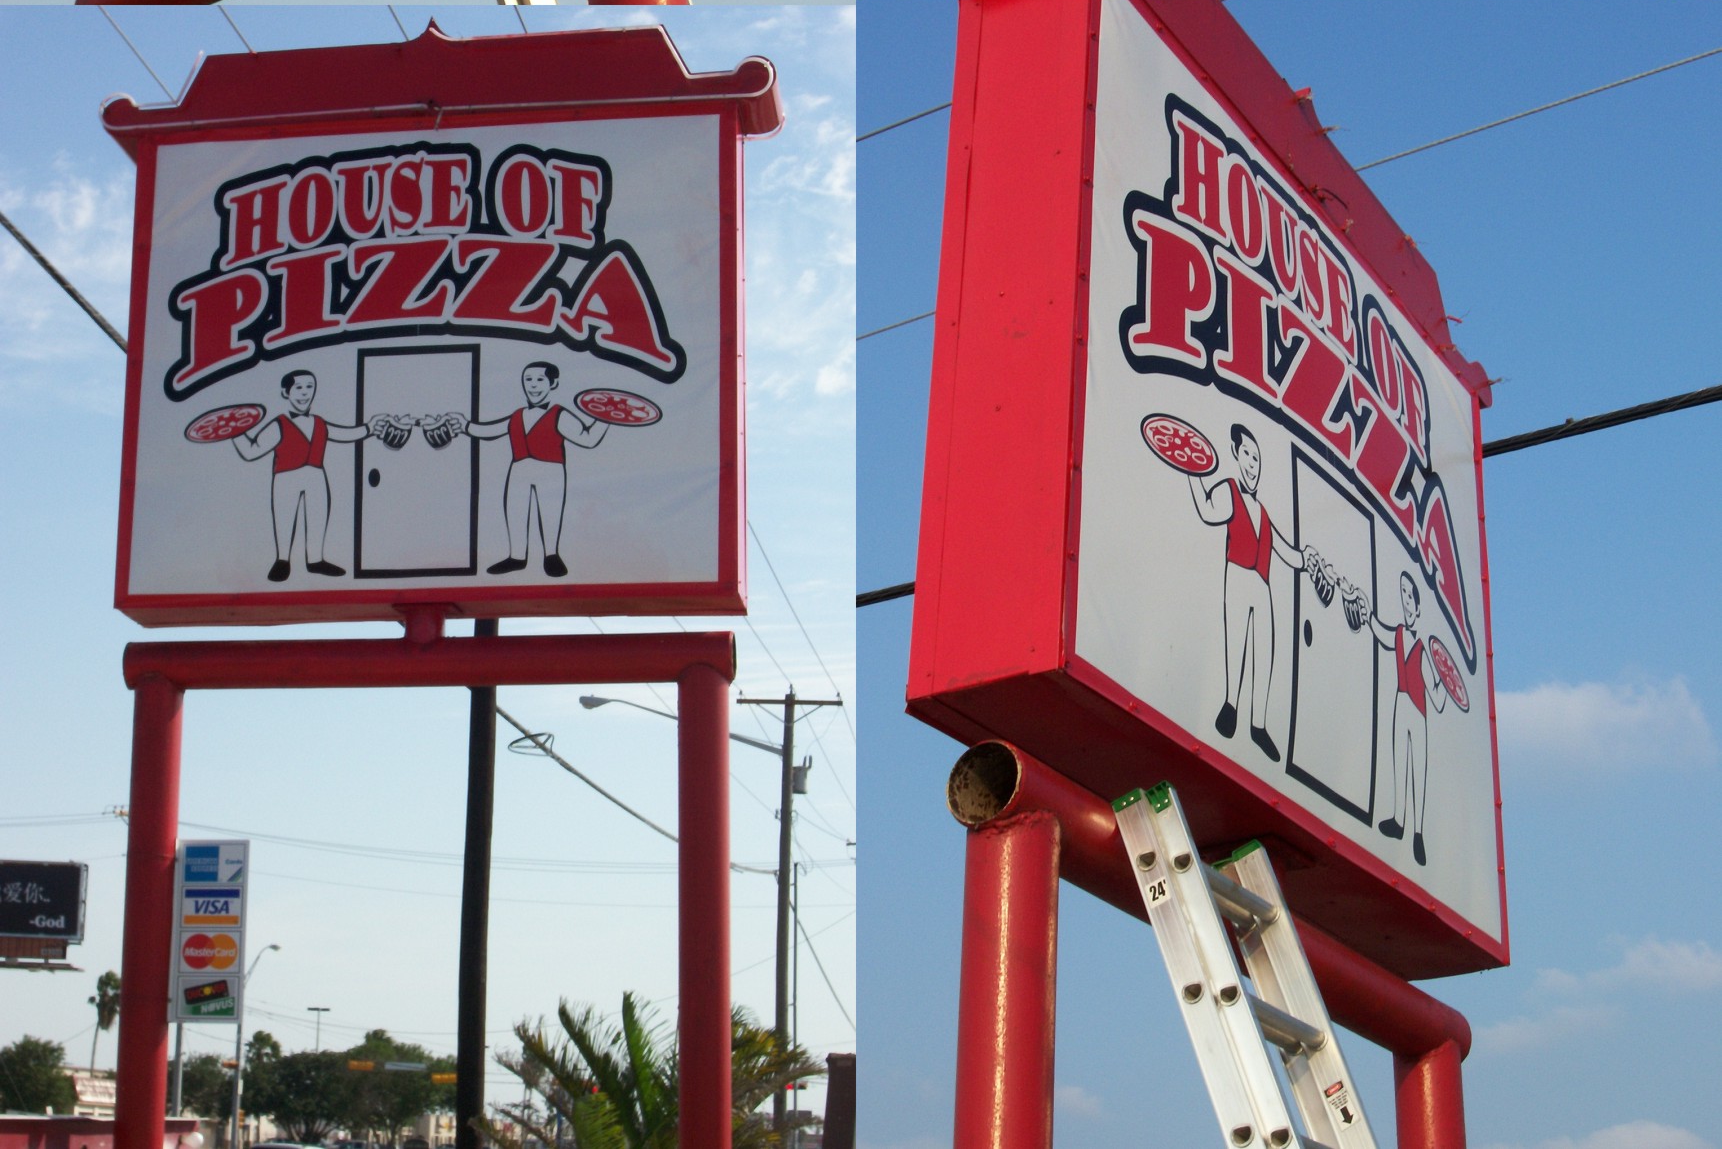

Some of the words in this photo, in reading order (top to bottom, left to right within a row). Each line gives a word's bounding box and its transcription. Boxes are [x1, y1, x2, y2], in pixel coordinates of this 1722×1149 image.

[221, 153, 471, 268] HOUSE
[497, 154, 602, 248] OF
[172, 235, 677, 388] PIZZA
[1172, 110, 1357, 361] HOUSE
[1365, 307, 1428, 465] OF
[1128, 210, 1474, 657] PIZZA
[29, 915, 65, 928] -God
[193, 900, 230, 915] VISA
[1149, 879, 1166, 902] 24'
[184, 946, 237, 958] MasterCard
